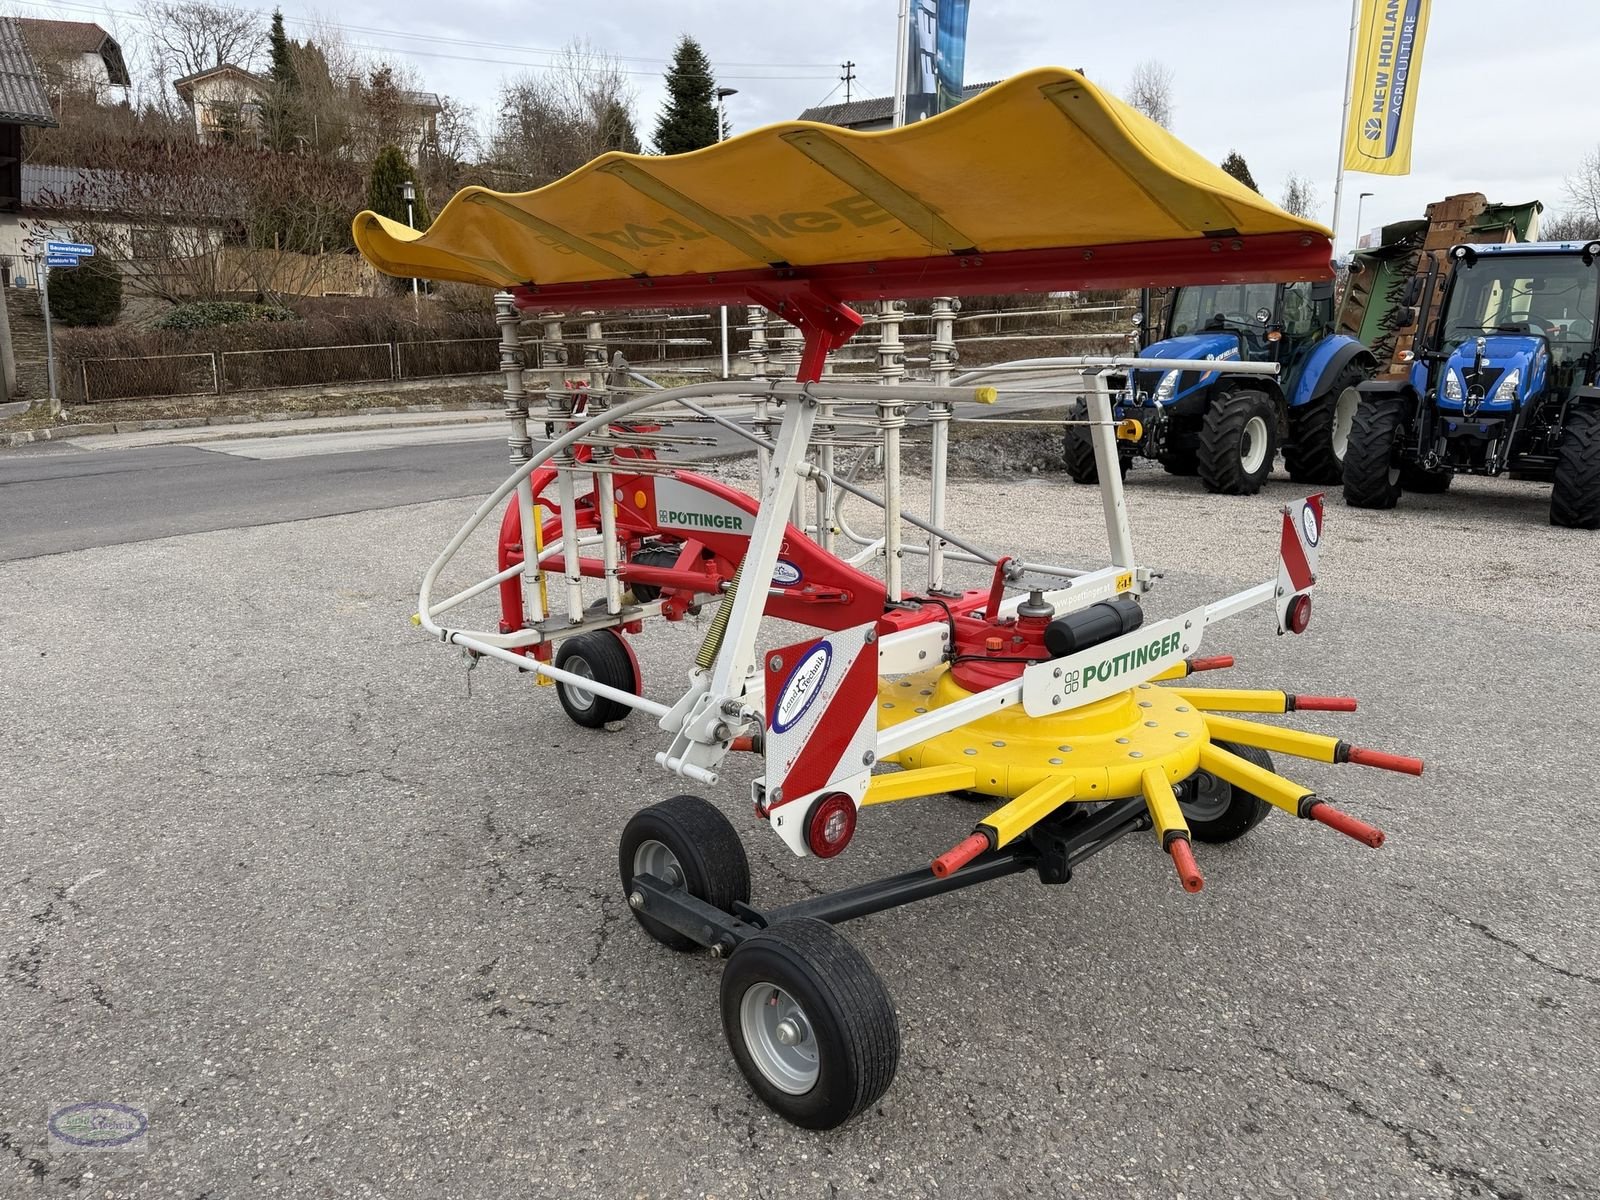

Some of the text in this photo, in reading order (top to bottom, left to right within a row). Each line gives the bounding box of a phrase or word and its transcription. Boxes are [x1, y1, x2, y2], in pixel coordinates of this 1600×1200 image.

[1373, 0, 1399, 113] NEW HOLLAN
[1392, 15, 1416, 116] AGRICULTURE
[669, 511, 743, 530] PÖTTINGER
[782, 689, 799, 714] Land
[801, 656, 825, 688] Technik
[1082, 631, 1181, 689] PÖTTINGER
